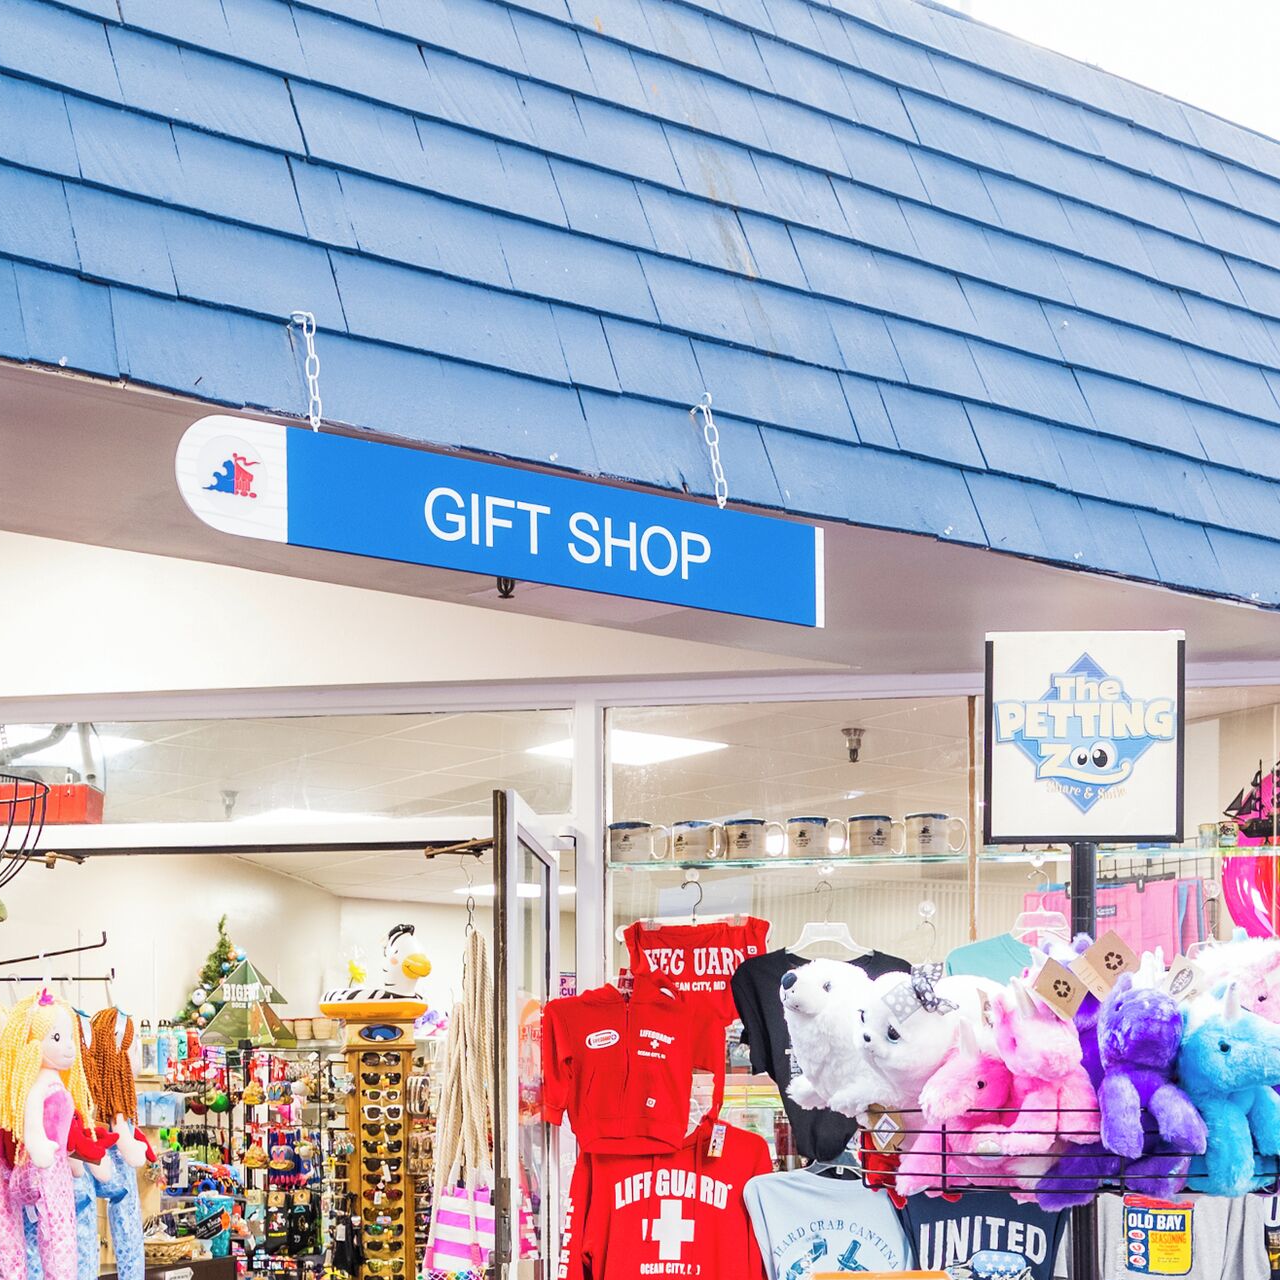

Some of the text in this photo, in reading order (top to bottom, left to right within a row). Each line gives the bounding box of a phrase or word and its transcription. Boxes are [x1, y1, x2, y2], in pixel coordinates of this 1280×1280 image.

[423, 486, 712, 580] GIFT SHOP
[1053, 675, 1122, 700] The
[996, 700, 1175, 739] PETTING
[1083, 787, 1094, 799] &
[1127, 1211, 1154, 1230] OLD
[773, 1218, 900, 1270] HARD CRAB CANTINA
[919, 1215, 1048, 1272] UNITED
[1149, 1231, 1187, 1244] SEASONING
[639, 1262, 665, 1275] OCEAN
